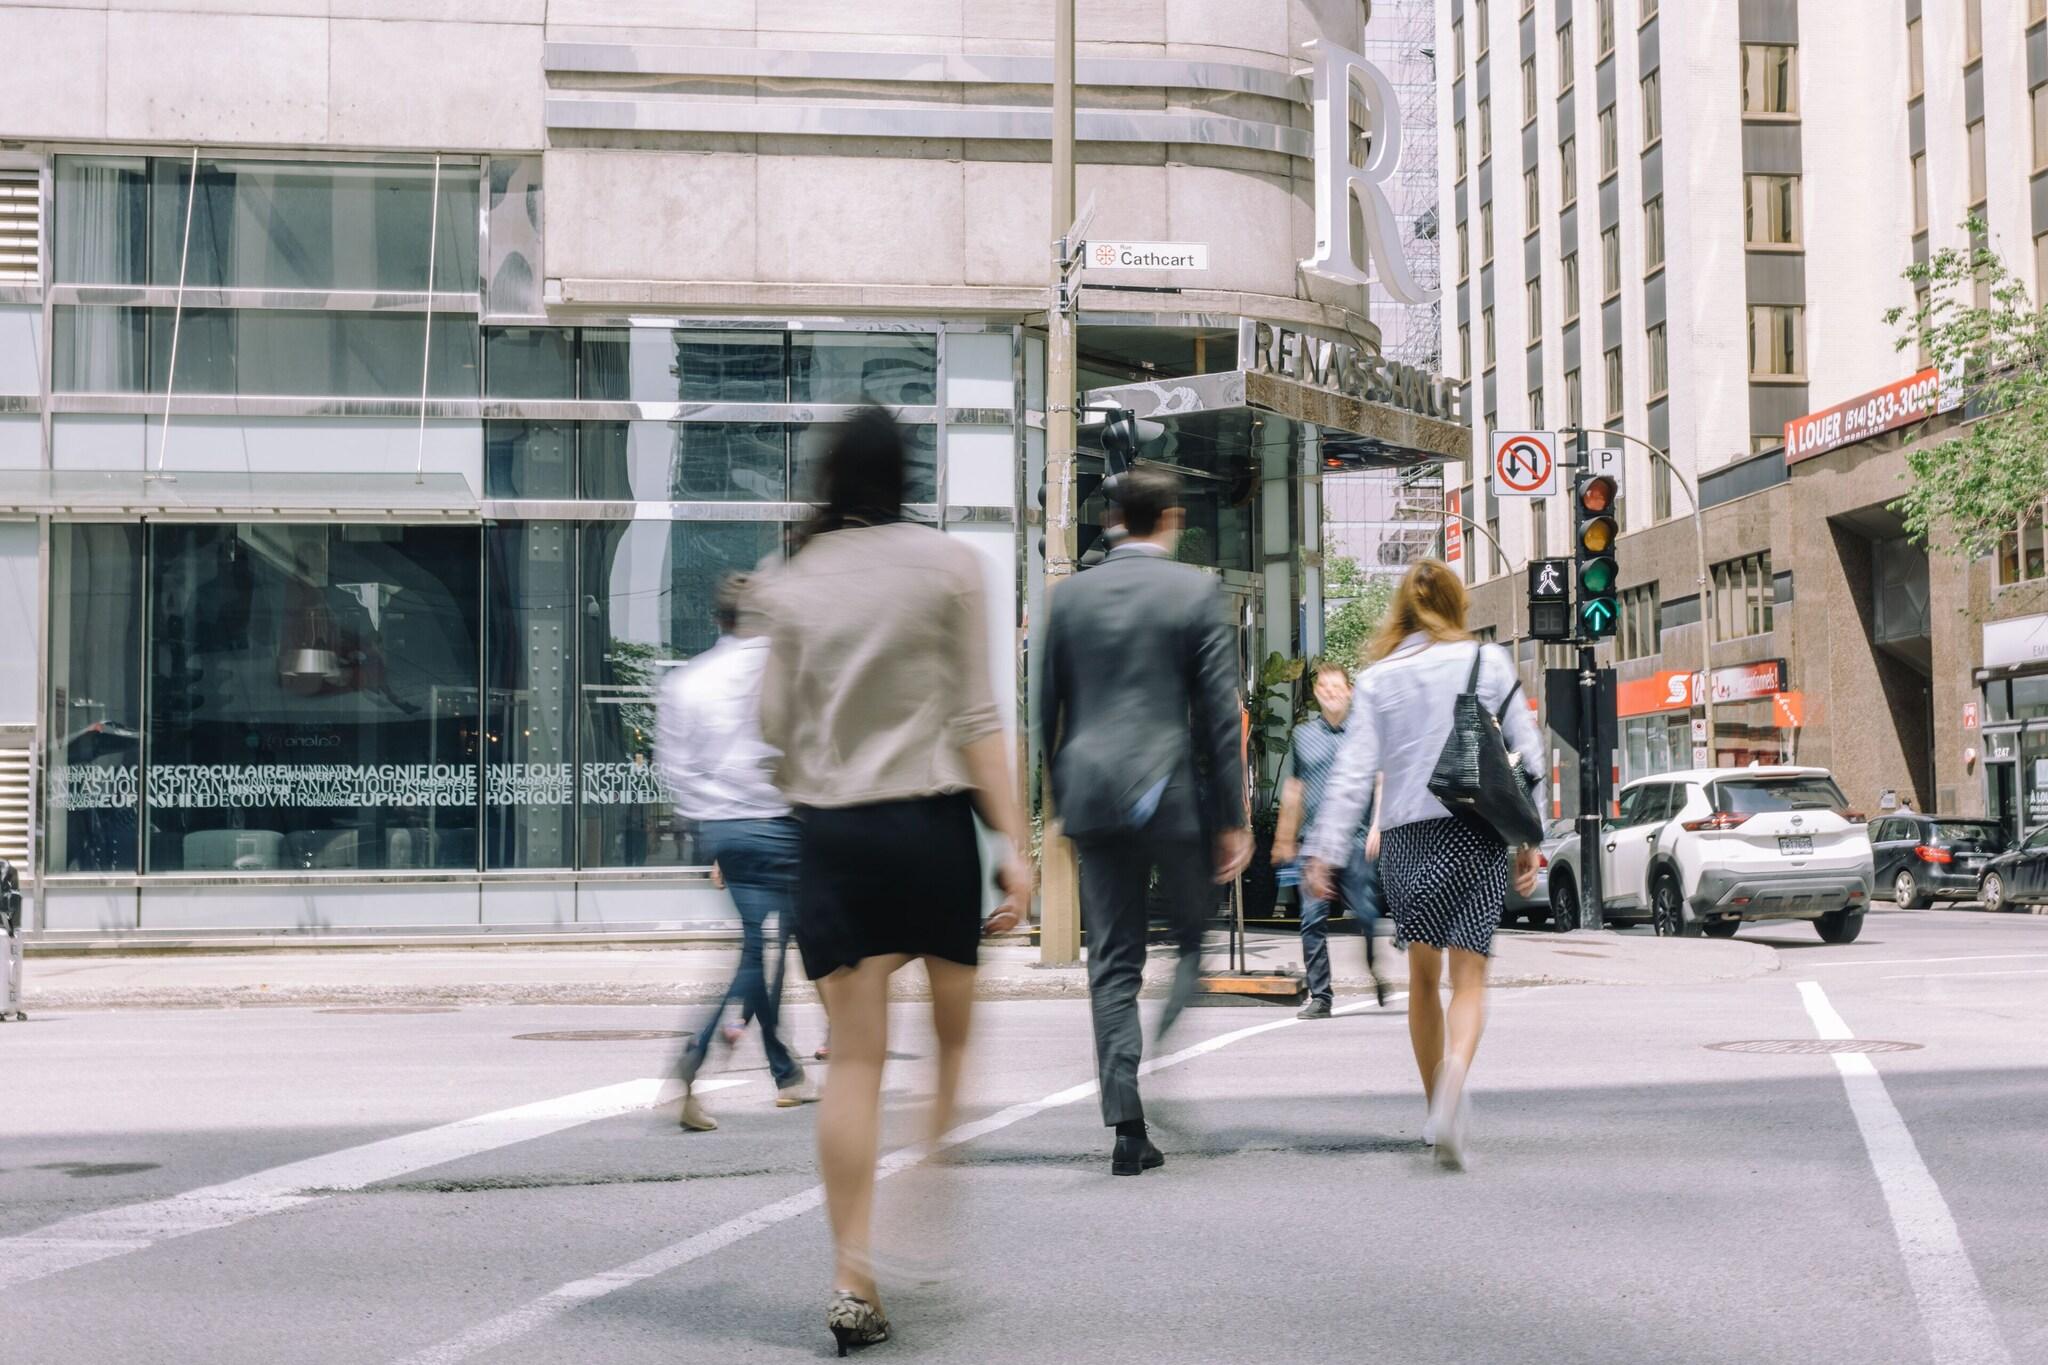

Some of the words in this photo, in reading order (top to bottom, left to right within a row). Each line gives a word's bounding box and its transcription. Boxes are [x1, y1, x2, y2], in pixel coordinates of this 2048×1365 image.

[1297, 39, 1443, 304] R
[1121, 251, 1194, 266] Cathcart
[1787, 423, 1796, 456] À
[1799, 412, 1841, 452] LOUER
[1845, 406, 1866, 433] (514)
[1867, 376, 1937, 427] 933-3000
[1601, 452, 1612, 468] P
[348, 764, 477, 780] MAGNIFIQUE
[348, 792, 477, 807] EUPHORIQUE
